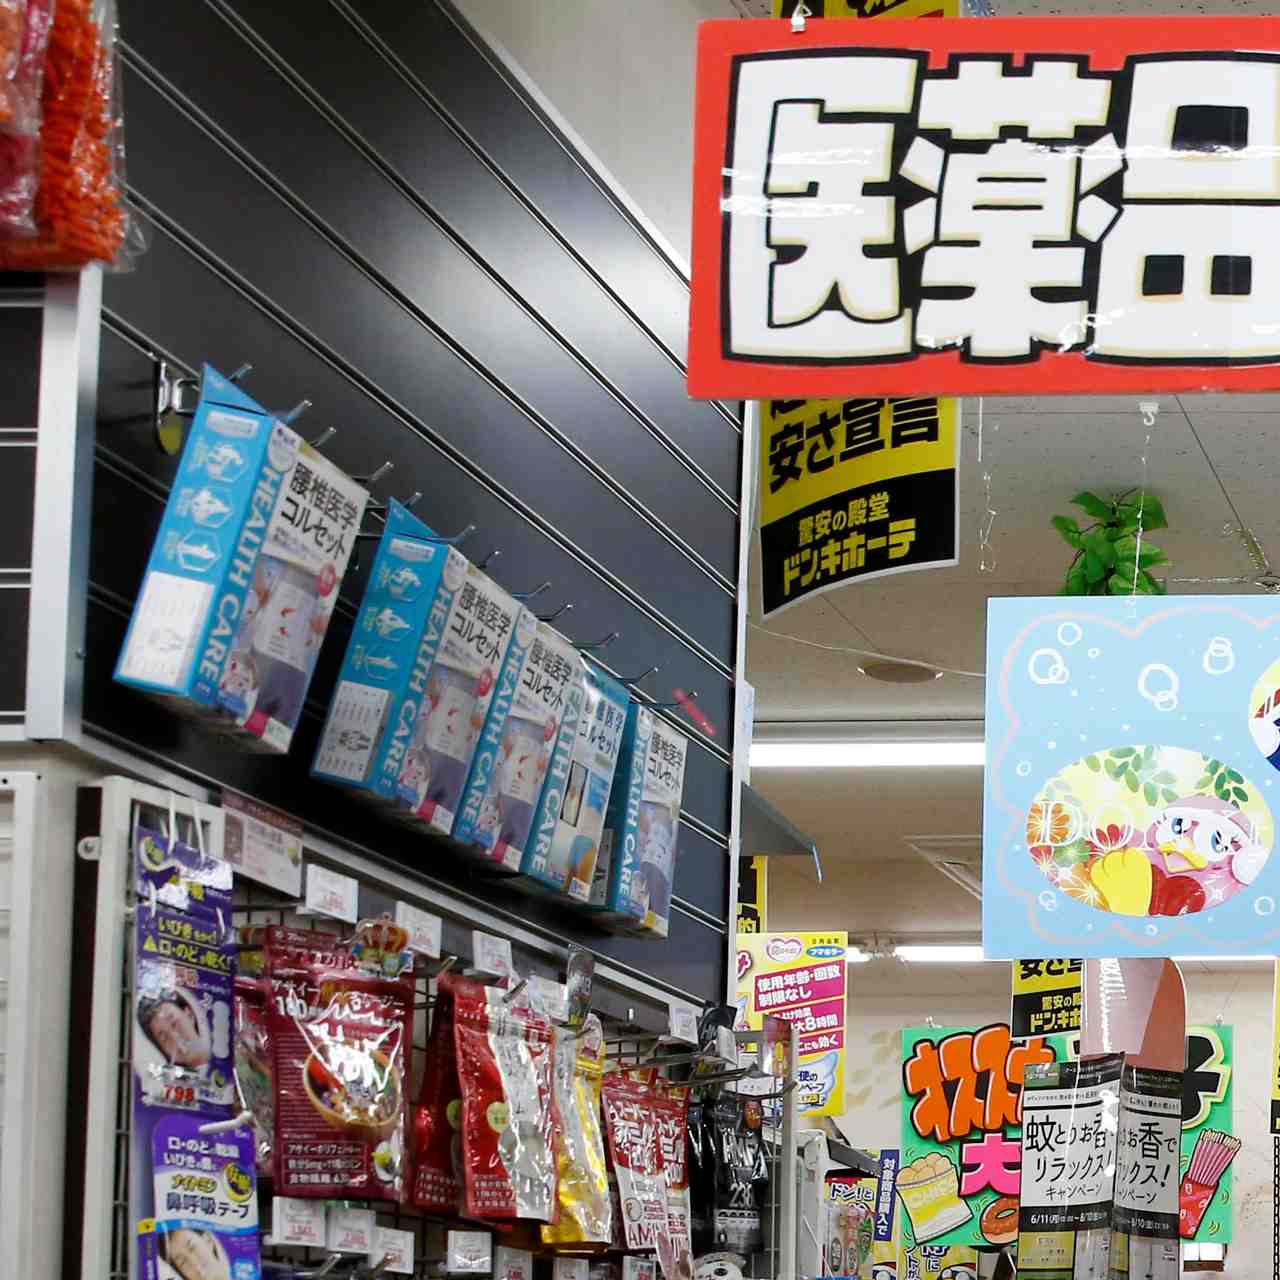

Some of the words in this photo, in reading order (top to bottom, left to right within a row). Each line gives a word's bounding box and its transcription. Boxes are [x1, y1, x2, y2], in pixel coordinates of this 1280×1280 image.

[768, 398, 940, 494] 安さ宣言
[228, 464, 282, 589] HEALTH
[198, 592, 242, 686] CARE
[416, 585, 452, 686] HEALTH
[381, 690, 421, 779] CARE
[490, 645, 526, 745] HEALTH
[461, 749, 495, 829] CARE
[528, 789, 566, 873] CARE
[630, 743, 652, 829] HEALTH
[620, 833, 638, 906] CARE
